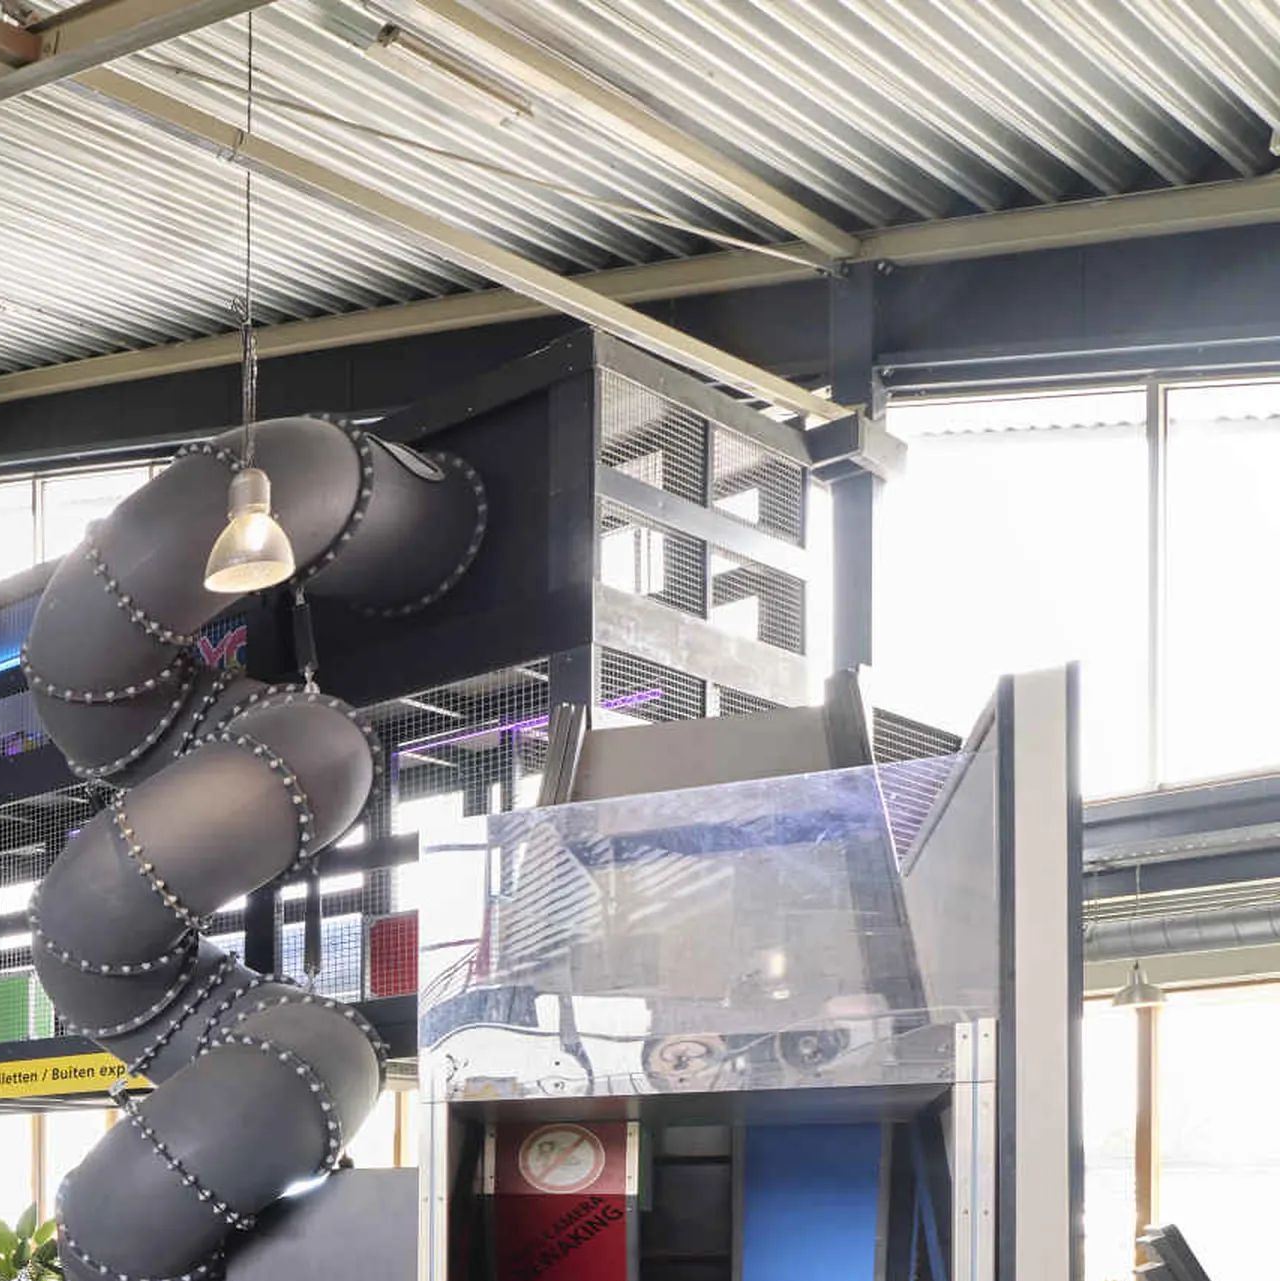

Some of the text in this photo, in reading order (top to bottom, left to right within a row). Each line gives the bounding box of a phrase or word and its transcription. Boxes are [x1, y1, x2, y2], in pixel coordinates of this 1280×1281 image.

[41, 1066, 48, 1082] /
[51, 1065, 96, 1081] Buiten
[99, 1062, 127, 1080] exp
[543, 1196, 605, 1240] CAMERA
[511, 1204, 624, 1281] WAKING
